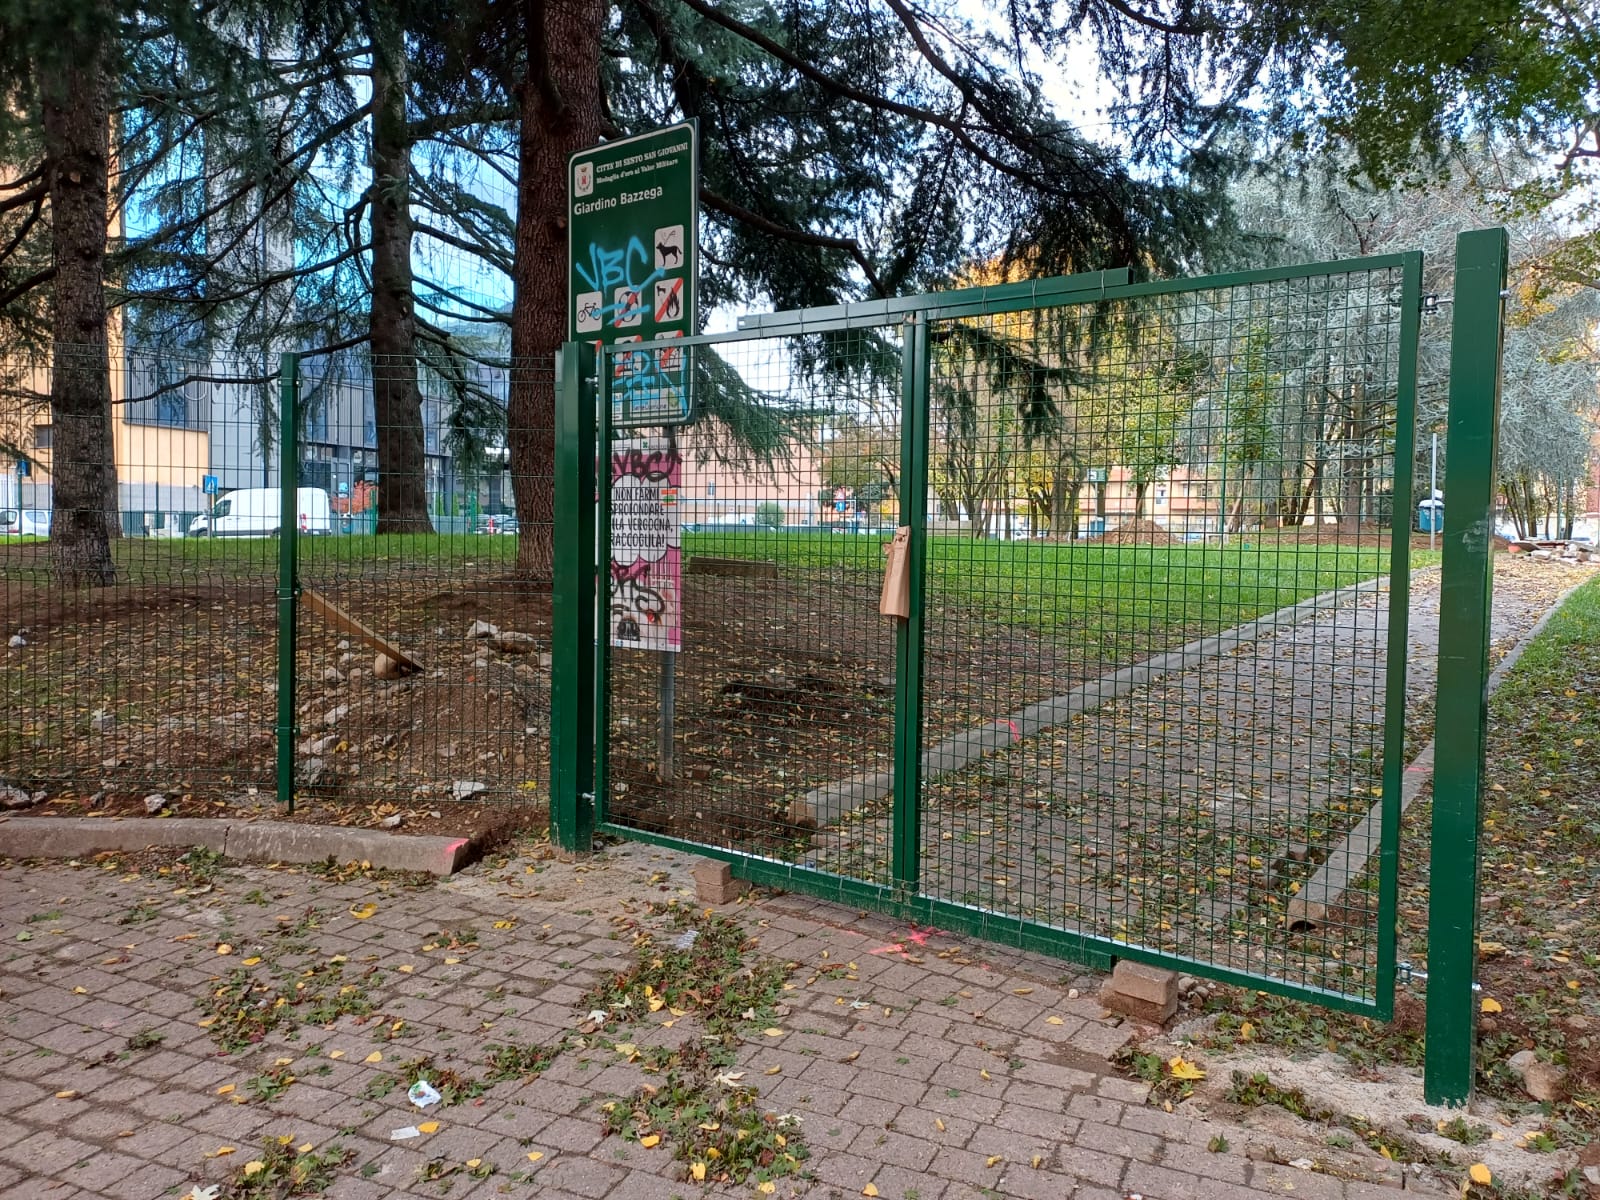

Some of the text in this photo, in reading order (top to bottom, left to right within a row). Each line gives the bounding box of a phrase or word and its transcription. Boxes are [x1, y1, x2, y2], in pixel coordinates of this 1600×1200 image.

[615, 159, 622, 169] DI
[623, 154, 643, 166] SESTO
[644, 150, 657, 161] SAN
[657, 142, 688, 157] GIOVANNI
[574, 185, 663, 215] Giardino Bazzega
[615, 487, 659, 501] NON FARMI
[628, 518, 673, 533] VERGOGNA,
